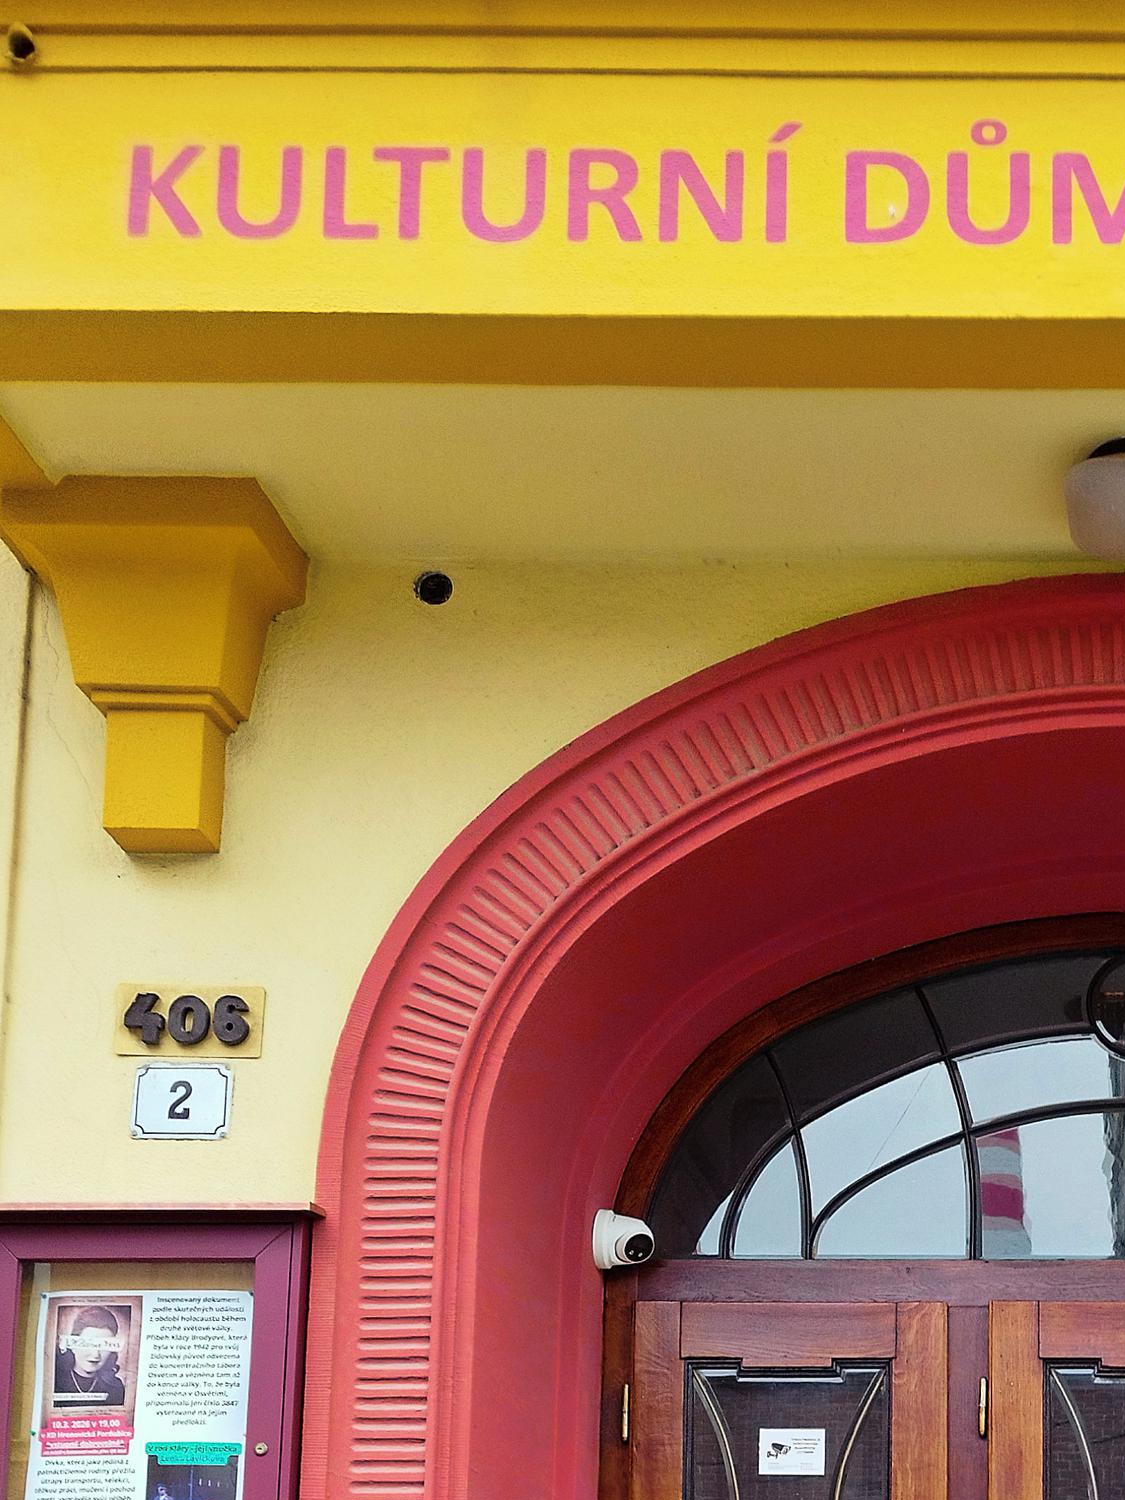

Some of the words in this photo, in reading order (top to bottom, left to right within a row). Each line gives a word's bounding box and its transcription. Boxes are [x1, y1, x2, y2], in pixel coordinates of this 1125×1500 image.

[128, 121, 802, 244] KULTURNÍ
[124, 993, 250, 1046] 406
[168, 1080, 192, 1119] 2
